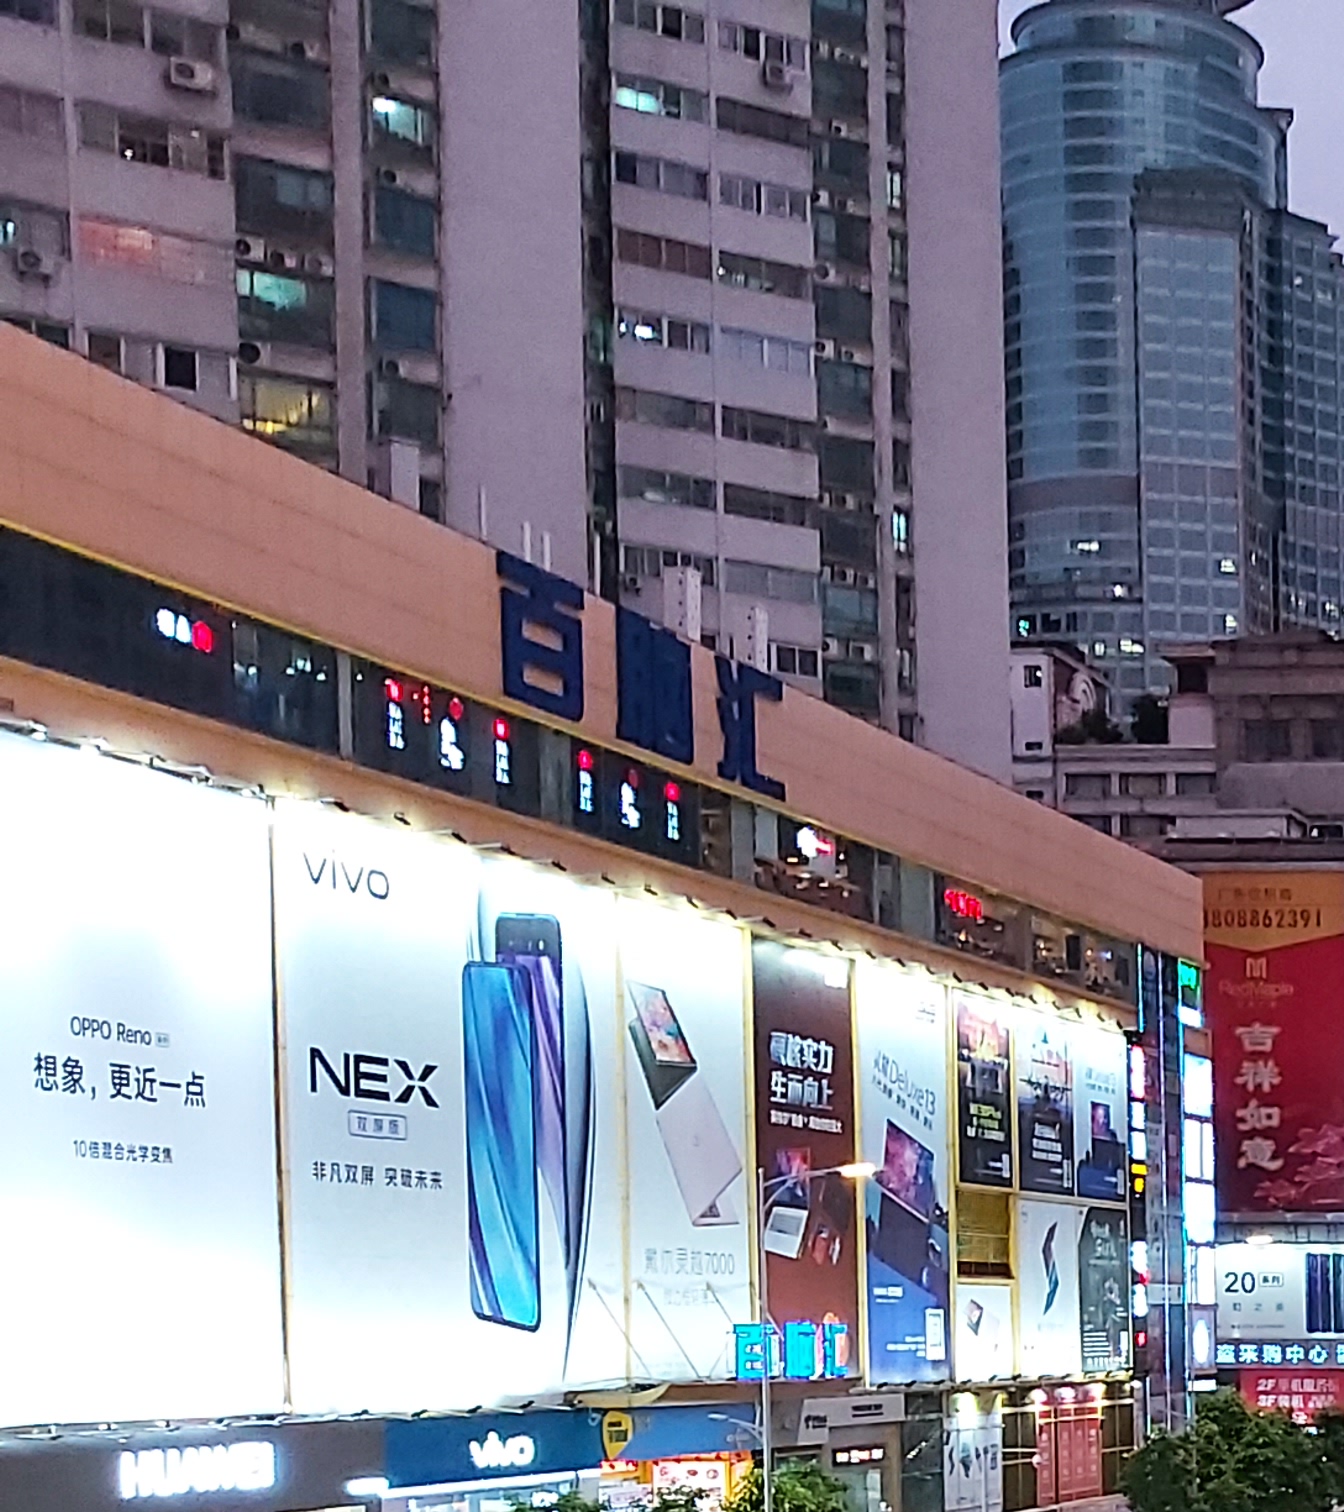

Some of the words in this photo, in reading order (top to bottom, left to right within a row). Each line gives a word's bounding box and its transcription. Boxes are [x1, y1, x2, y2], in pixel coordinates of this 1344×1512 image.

[303, 851, 390, 899] vivo
[70, 1016, 112, 1040] OPPO
[117, 1022, 152, 1046] Reno
[309, 1047, 440, 1108] NEX
[1234, 1022, 1284, 1172] 吉祥如意
[312, 1160, 375, 1186] 非凡双屏
[1224, 1271, 1256, 1294] 20
[118, 1440, 276, 1499] HUAWEI
[468, 1429, 536, 1469] vivo
